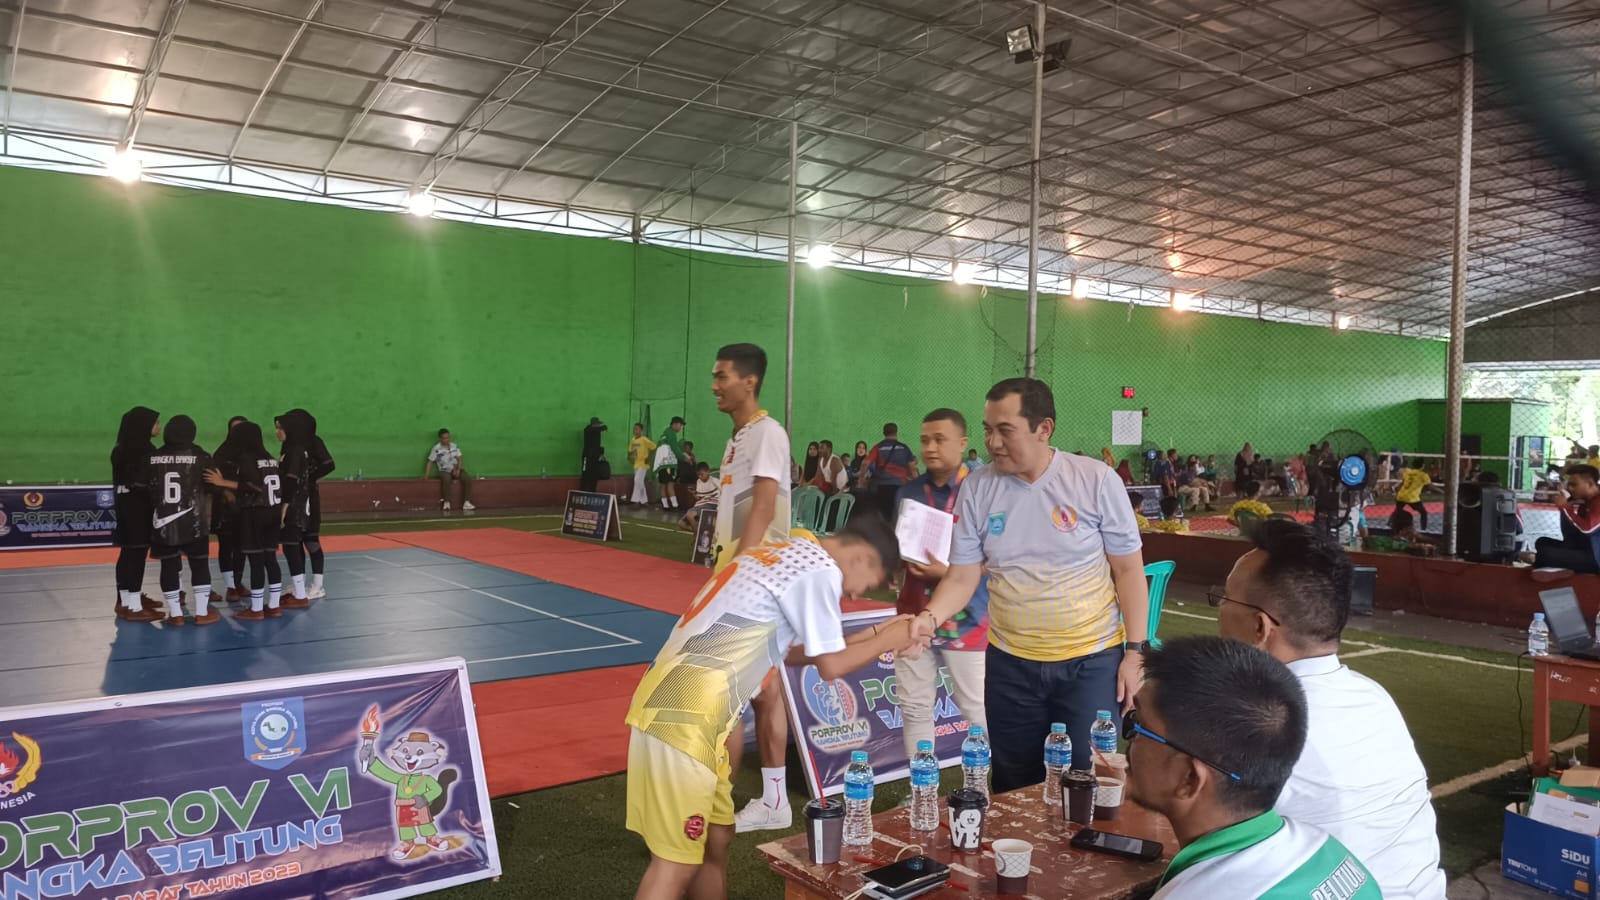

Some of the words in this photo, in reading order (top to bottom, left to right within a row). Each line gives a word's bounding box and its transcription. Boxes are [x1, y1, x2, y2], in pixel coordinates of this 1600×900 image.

[164, 471, 181, 503] 6
[11, 510, 104, 525] PORPROV
[811, 723, 855, 740] PORPROV
[288, 767, 352, 819] VI
[147, 815, 345, 876] BELITUNG
[185, 871, 248, 898] TAHUN
[248, 861, 302, 885] 2023
